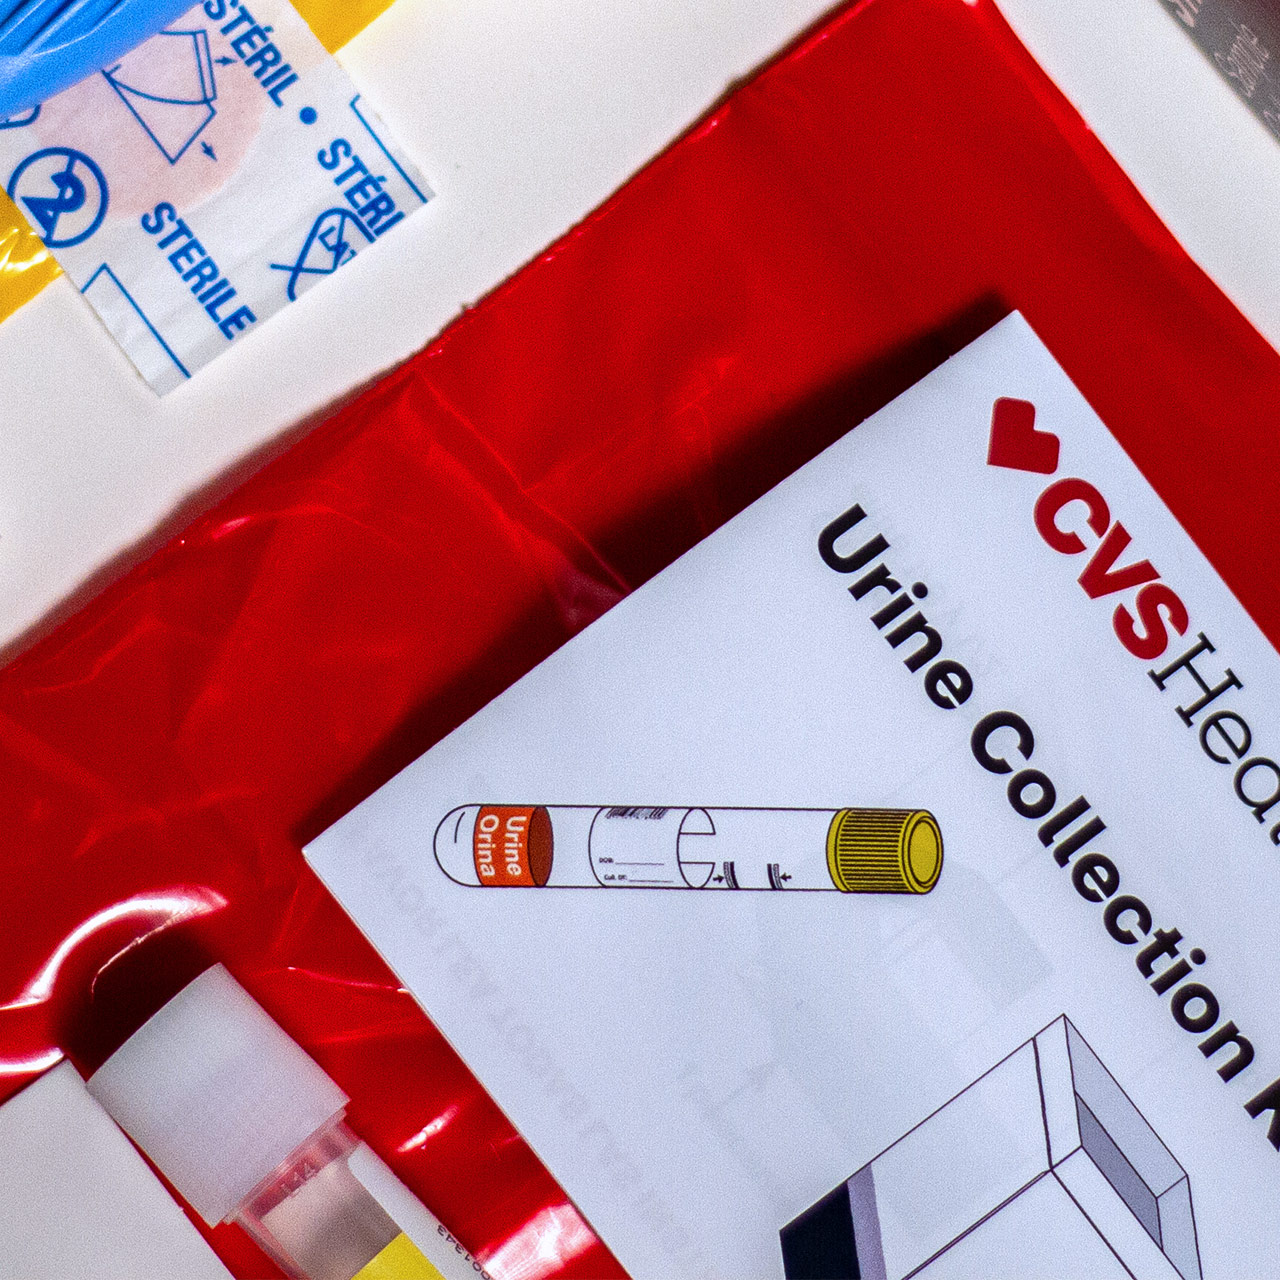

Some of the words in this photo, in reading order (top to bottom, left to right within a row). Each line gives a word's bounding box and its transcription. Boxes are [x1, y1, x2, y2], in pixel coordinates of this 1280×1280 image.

[141, 201, 258, 340] STERILE
[813, 501, 982, 714] Urine
[965, 704, 1263, 1085] Collection
[477, 812, 500, 877] Orina
[503, 814, 528, 877] Urine
